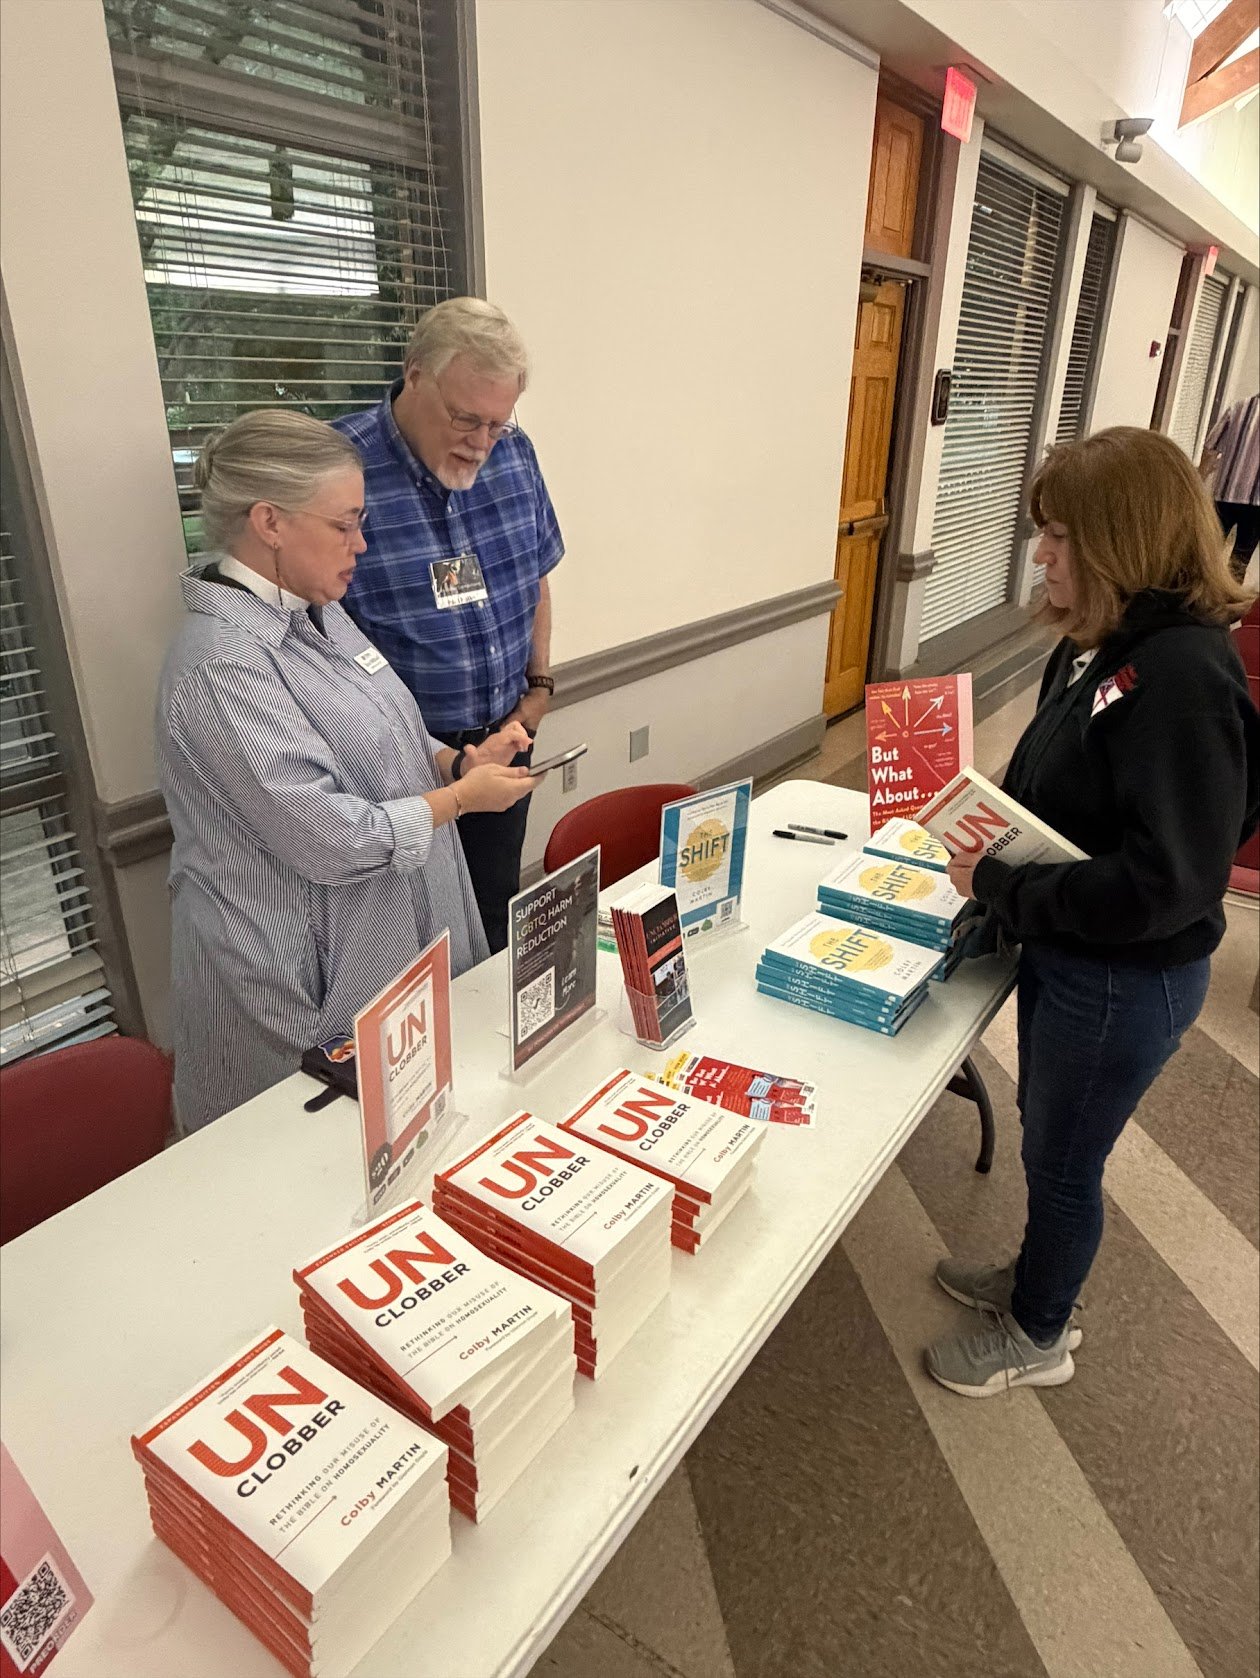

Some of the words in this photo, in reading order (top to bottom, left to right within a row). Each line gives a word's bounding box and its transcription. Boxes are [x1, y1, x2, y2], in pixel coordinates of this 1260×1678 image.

[871, 766, 913, 785] What
[872, 746, 899, 763] But
[679, 833, 730, 867] SHIFT
[943, 801, 1011, 853] UN
[987, 827, 1023, 856] OBBER
[516, 887, 557, 922] SUPPORT
[872, 865, 921, 900] SHIFT
[516, 913, 547, 941] LGBTQ
[547, 895, 572, 920] HARM
[517, 915, 567, 959] REDUCTION
[821, 929, 878, 970] SHIFT
[823, 937, 840, 948] THE
[790, 986, 832, 1003] SHIFT
[792, 978, 836, 995] SHIFT
[800, 963, 843, 982] SHIFT
[387, 999, 427, 1067] UN
[389, 1035, 428, 1083] CLOBBER
[597, 1087, 677, 1142] UN
[639, 1103, 691, 1152] CLOBBER
[478, 1135, 576, 1199] UN
[714, 1146, 731, 1163] Colby
[728, 1124, 750, 1146] MARTIN
[521, 1156, 591, 1211] CLOBBER
[592, 1171, 628, 1203] HOMOSEXUALITY
[603, 1209, 627, 1230] Colby
[625, 1182, 654, 1209] MARTIN
[551, 1200, 583, 1227] RETHINKING
[337, 1231, 457, 1311] UN
[375, 1262, 471, 1327] CLOBBER
[400, 1318, 446, 1351] RETHINKING
[447, 1307, 462, 1319] OUR
[463, 1288, 490, 1307] MISUSE
[491, 1281, 500, 1290] OF
[408, 1347, 422, 1358] THE
[424, 1332, 444, 1347] BIBLE
[445, 1323, 455, 1332] ON
[456, 1287, 508, 1324] HOMOSEXUALITY
[459, 1336, 491, 1361] Colby
[491, 1304, 533, 1337] MARTIN
[187, 1366, 329, 1478] UN
[237, 1400, 346, 1498] CLOBBER
[269, 1475, 321, 1526] RETHINKING
[322, 1457, 340, 1474] OUR
[340, 1428, 370, 1457] MISUSE
[370, 1417, 381, 1428] OF
[279, 1517, 297, 1533] THE
[298, 1493, 321, 1517] BIBLE
[321, 1480, 333, 1492] ON
[334, 1423, 390, 1480] HOMOSEXUALITY
[341, 1490, 376, 1527] Colby
[376, 1443, 421, 1489] MARTIN
